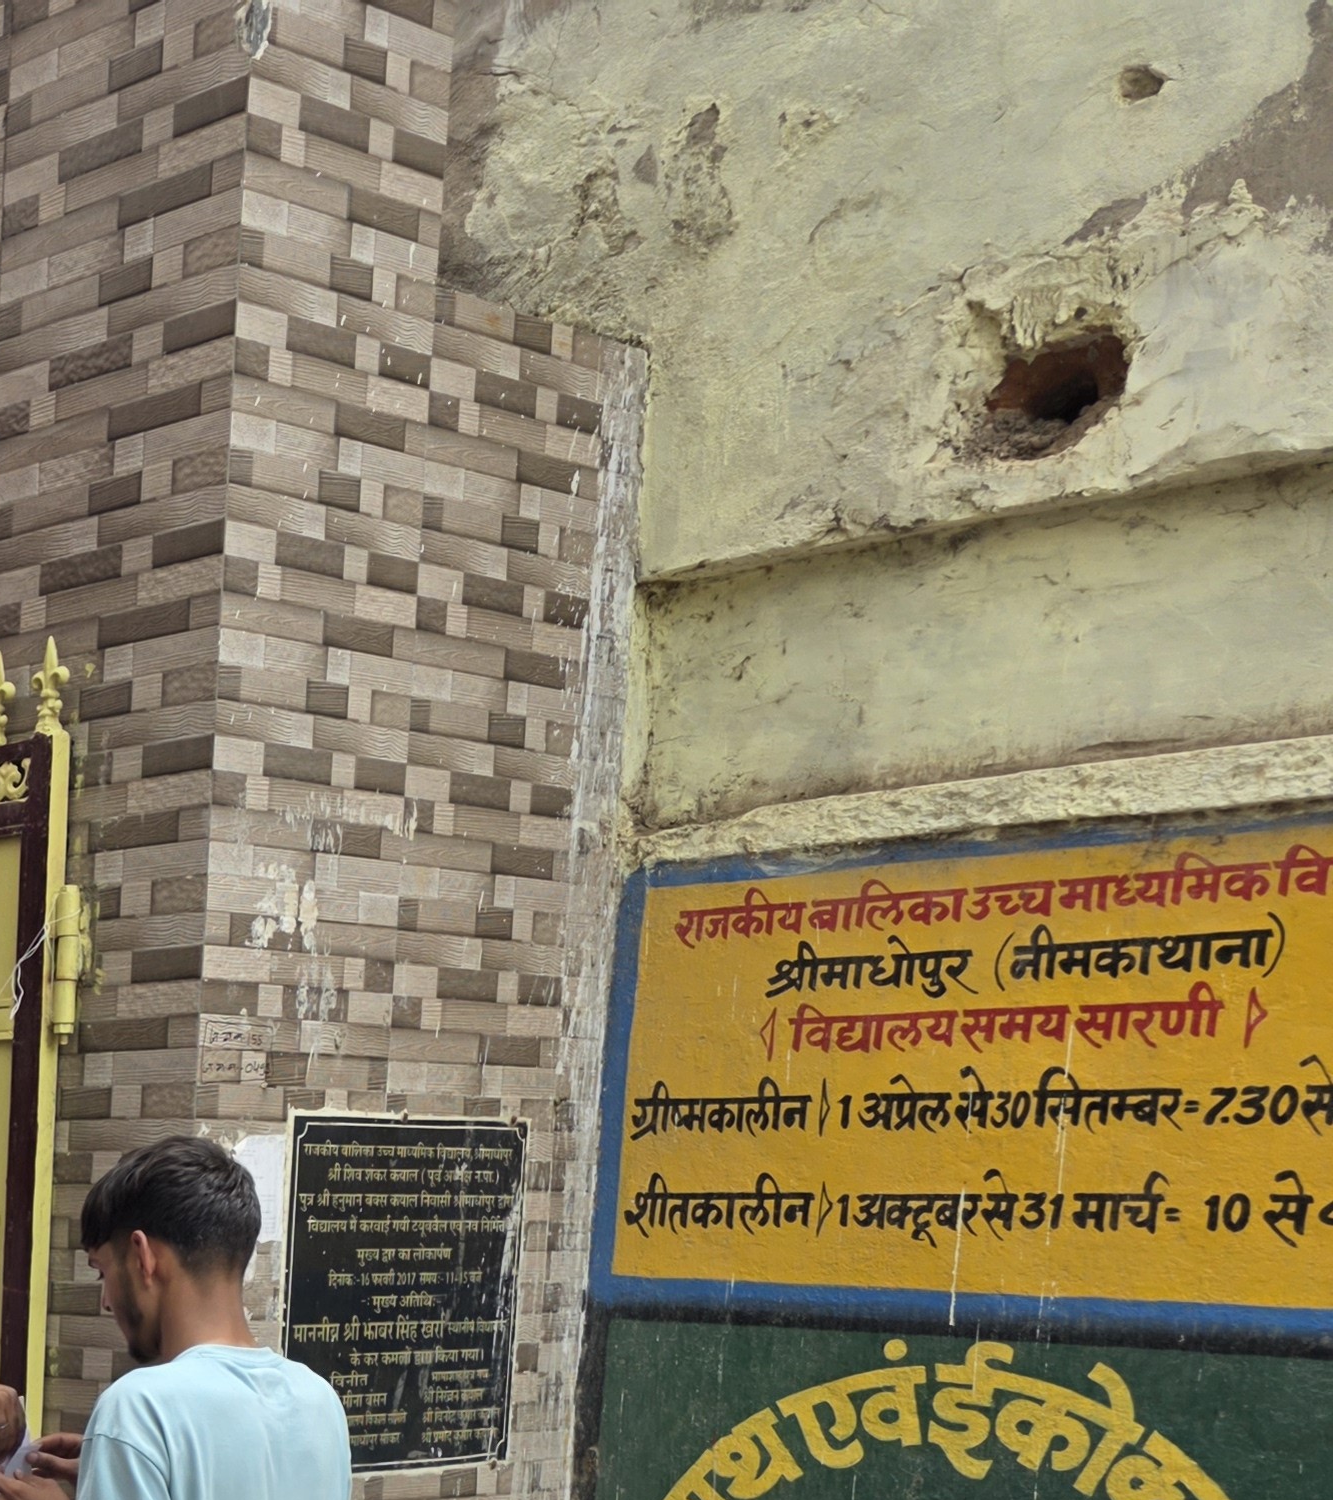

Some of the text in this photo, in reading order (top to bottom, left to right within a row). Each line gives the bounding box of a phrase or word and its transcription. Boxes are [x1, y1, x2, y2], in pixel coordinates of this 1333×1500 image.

[675, 887, 807, 949] राजकीय
[808, 879, 968, 932] बालिका
[966, 880, 1056, 921] उच्च
[1058, 852, 1272, 912] माध्यमिक
[765, 911, 1285, 998] श्रीमाधोपुर (नीमकाथाना)
[788, 981, 1225, 1053] विद्यालय समय सारणी
[630, 1076, 812, 1141] ग्रीष्मकालीन
[837, 1094, 852, 1129] 1
[858, 1074, 953, 1133] अप्रेल
[954, 1065, 994, 1134] से
[991, 1089, 1032, 1129] 30
[317, 1188, 331, 1207] श्री
[332, 1193, 363, 1212] हनुमान
[328, 1162, 341, 1181] श्री
[343, 1163, 362, 1182] शिव
[307, 1215, 347, 1233] विद्यालय
[624, 1172, 815, 1238] शीतकालीन
[837, 1194, 850, 1227] 1
[853, 1193, 983, 1248] अक्टूबर
[981, 1169, 1019, 1241] से
[1020, 1192, 1065, 1230] 31
[1205, 1193, 1251, 1232] 10
[1263, 1170, 1315, 1248] से
[356, 1248, 379, 1267] मुख्य
[398, 1247, 411, 1260] का
[344, 1315, 361, 1341] श्री
[776, 1338, 927, 1469] एवं
